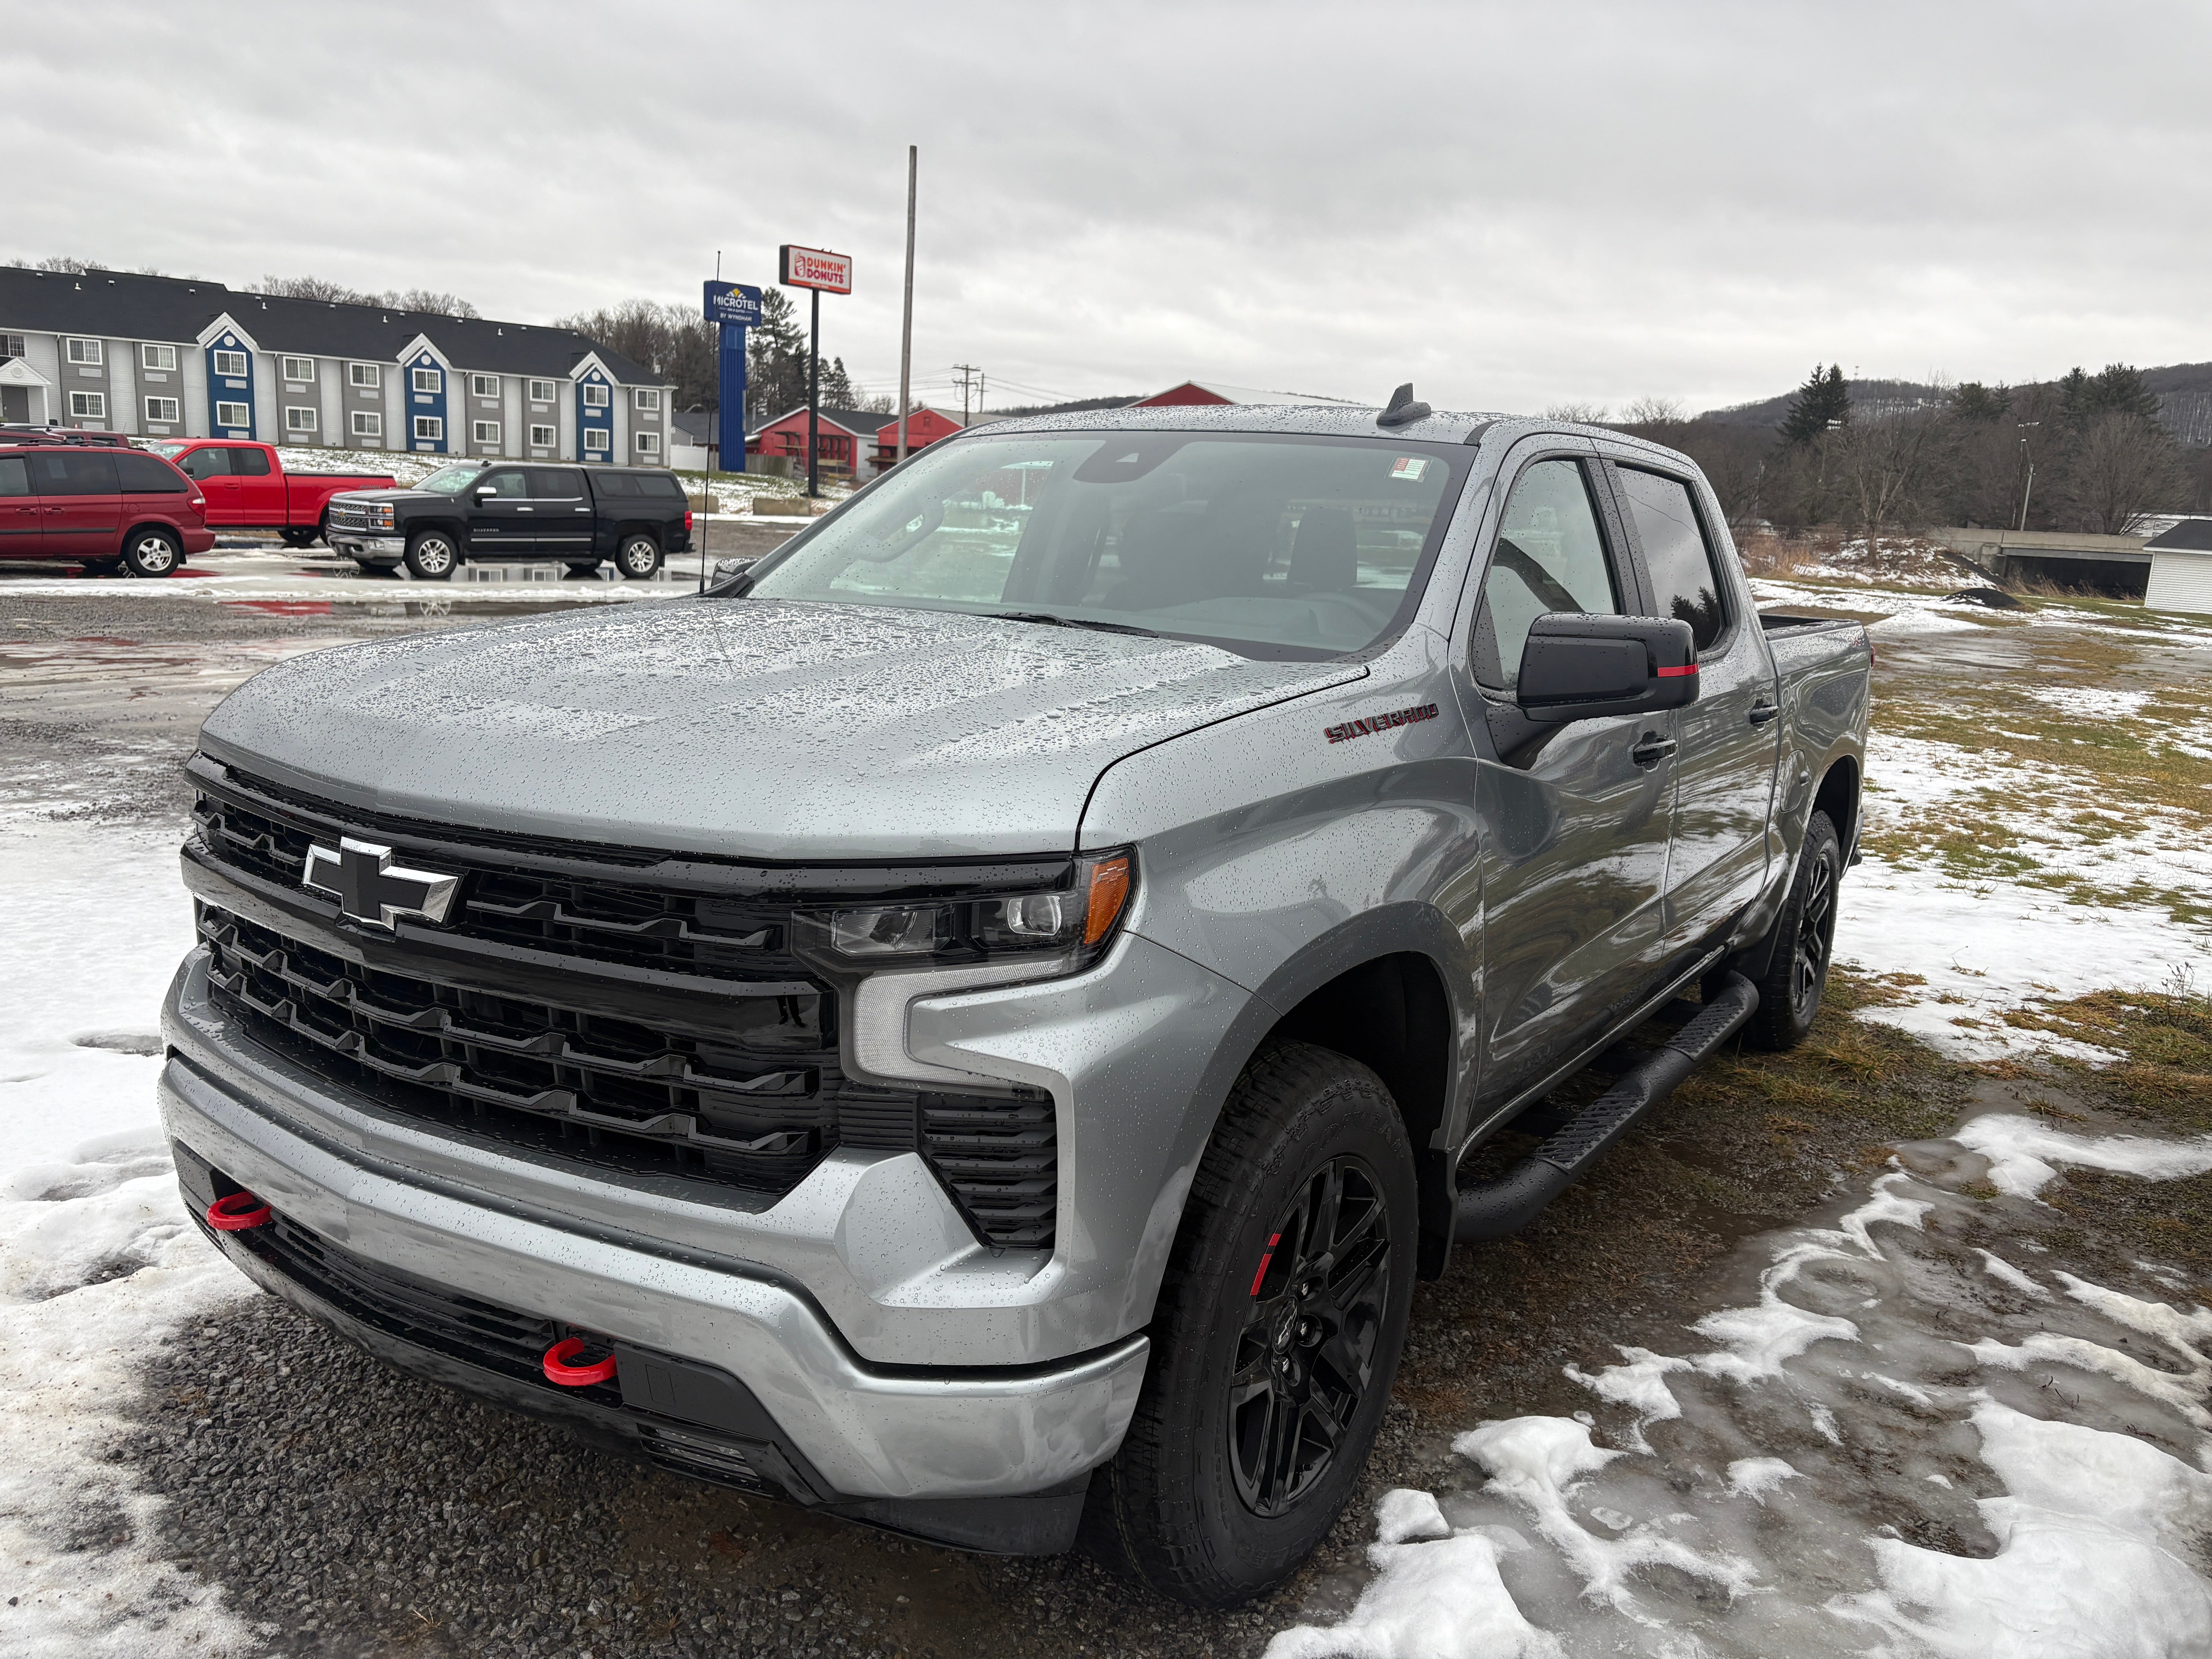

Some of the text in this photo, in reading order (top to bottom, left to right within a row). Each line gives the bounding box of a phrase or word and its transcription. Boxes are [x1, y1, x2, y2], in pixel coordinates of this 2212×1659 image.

[807, 258, 846, 273] DUNKIN'
[807, 268, 843, 284] DONUTS
[713, 294, 759, 311] MICROTEL
[1324, 703, 1439, 744] SILVERADO
